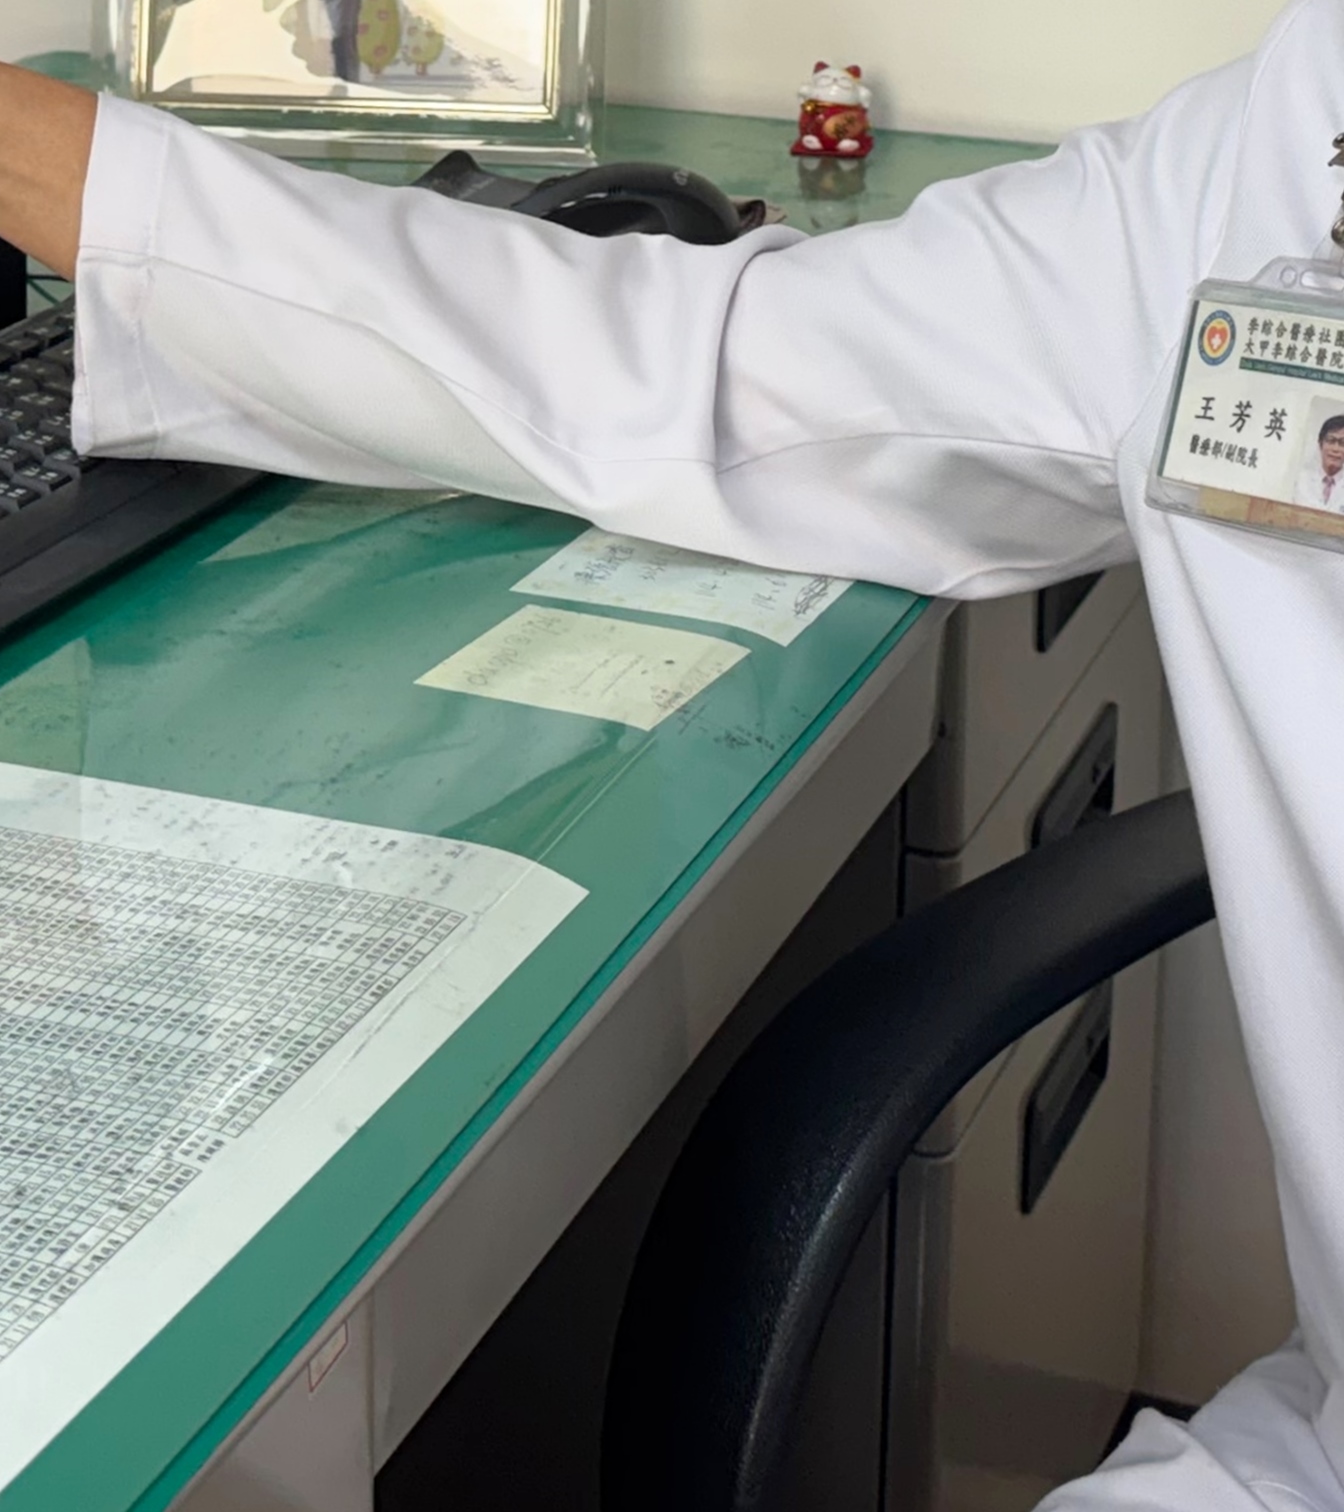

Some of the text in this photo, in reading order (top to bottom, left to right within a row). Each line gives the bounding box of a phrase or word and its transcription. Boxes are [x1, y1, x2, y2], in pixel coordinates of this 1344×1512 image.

[1243, 338, 1344, 369] 大甲李綜合醫院
[1194, 396, 1289, 441] 王芳英
